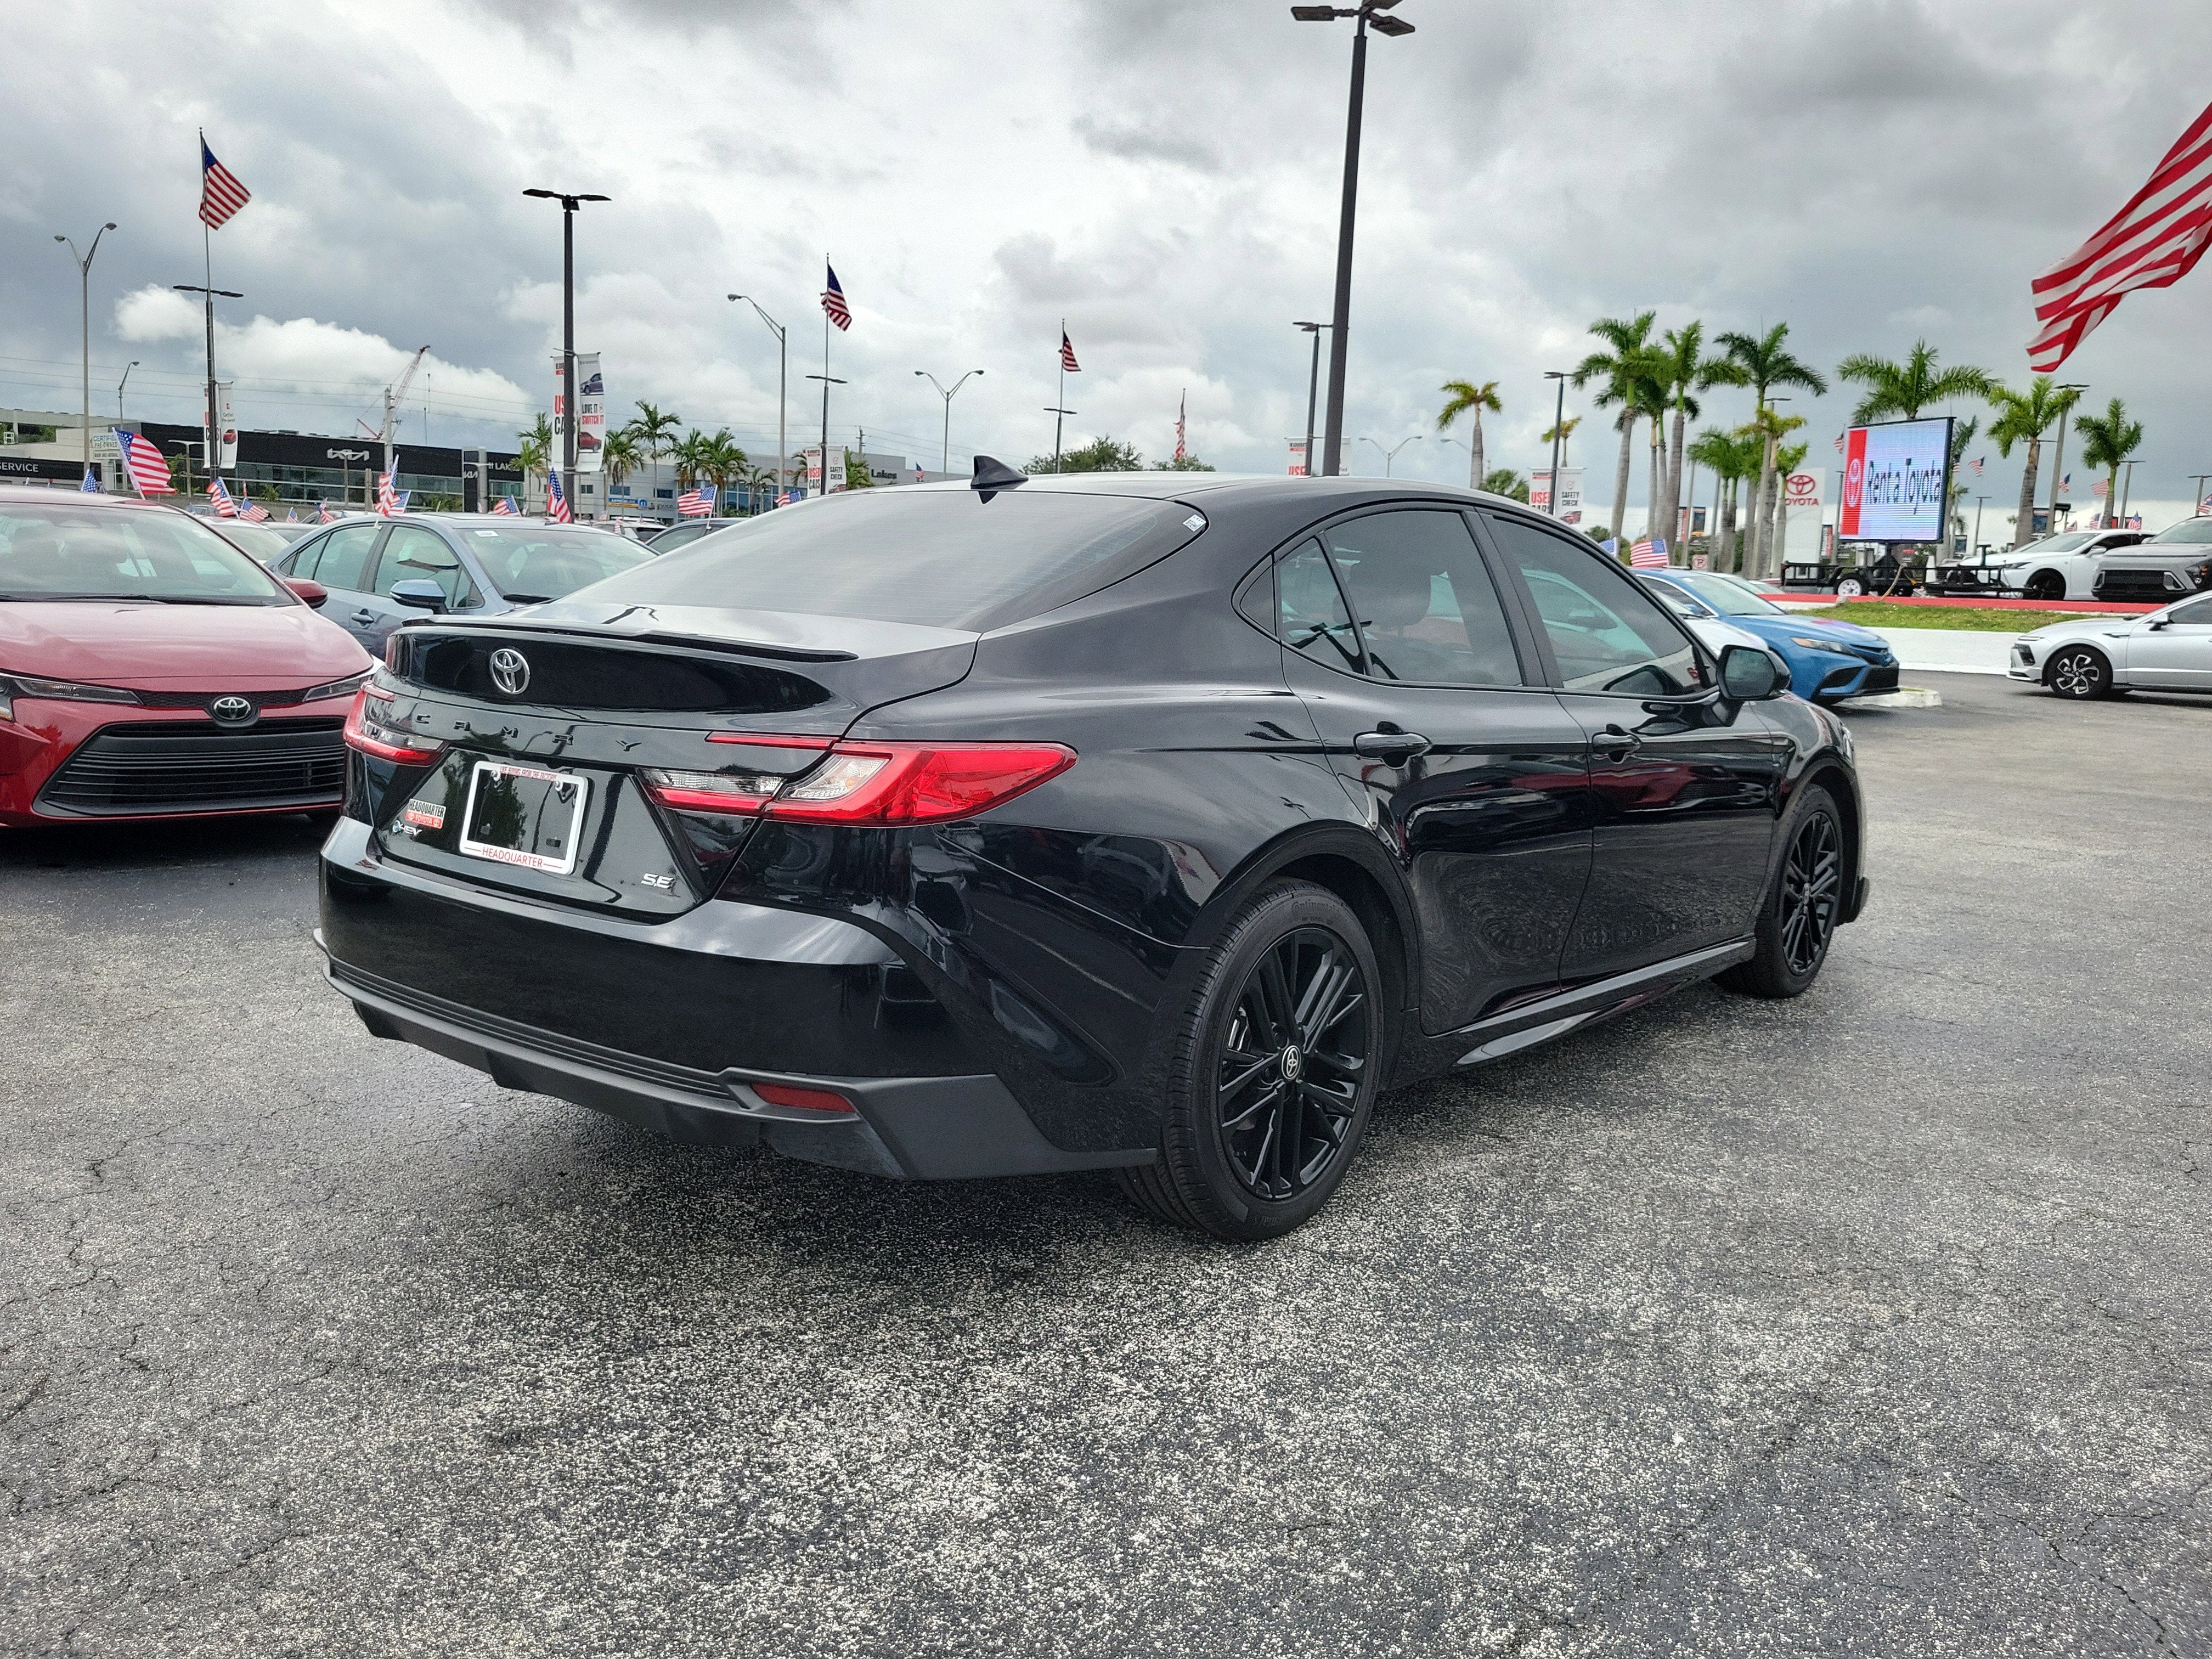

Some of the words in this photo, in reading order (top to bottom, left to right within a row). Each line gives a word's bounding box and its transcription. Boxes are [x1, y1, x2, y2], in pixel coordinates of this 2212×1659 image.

[0, 462, 39, 473] ERVICE
[809, 467, 821, 478] USED
[871, 469, 898, 479] Lakes
[809, 479, 820, 489] CARS
[1904, 458, 1942, 515] Toyota
[1531, 492, 1550, 504] USE
[416, 714, 642, 752] CAMRY
[408, 799, 445, 818] HEADQUARTER
[415, 814, 433, 825] TOYOTA
[482, 847, 543, 868] HEADQUARTER
[641, 873, 674, 889] SE
